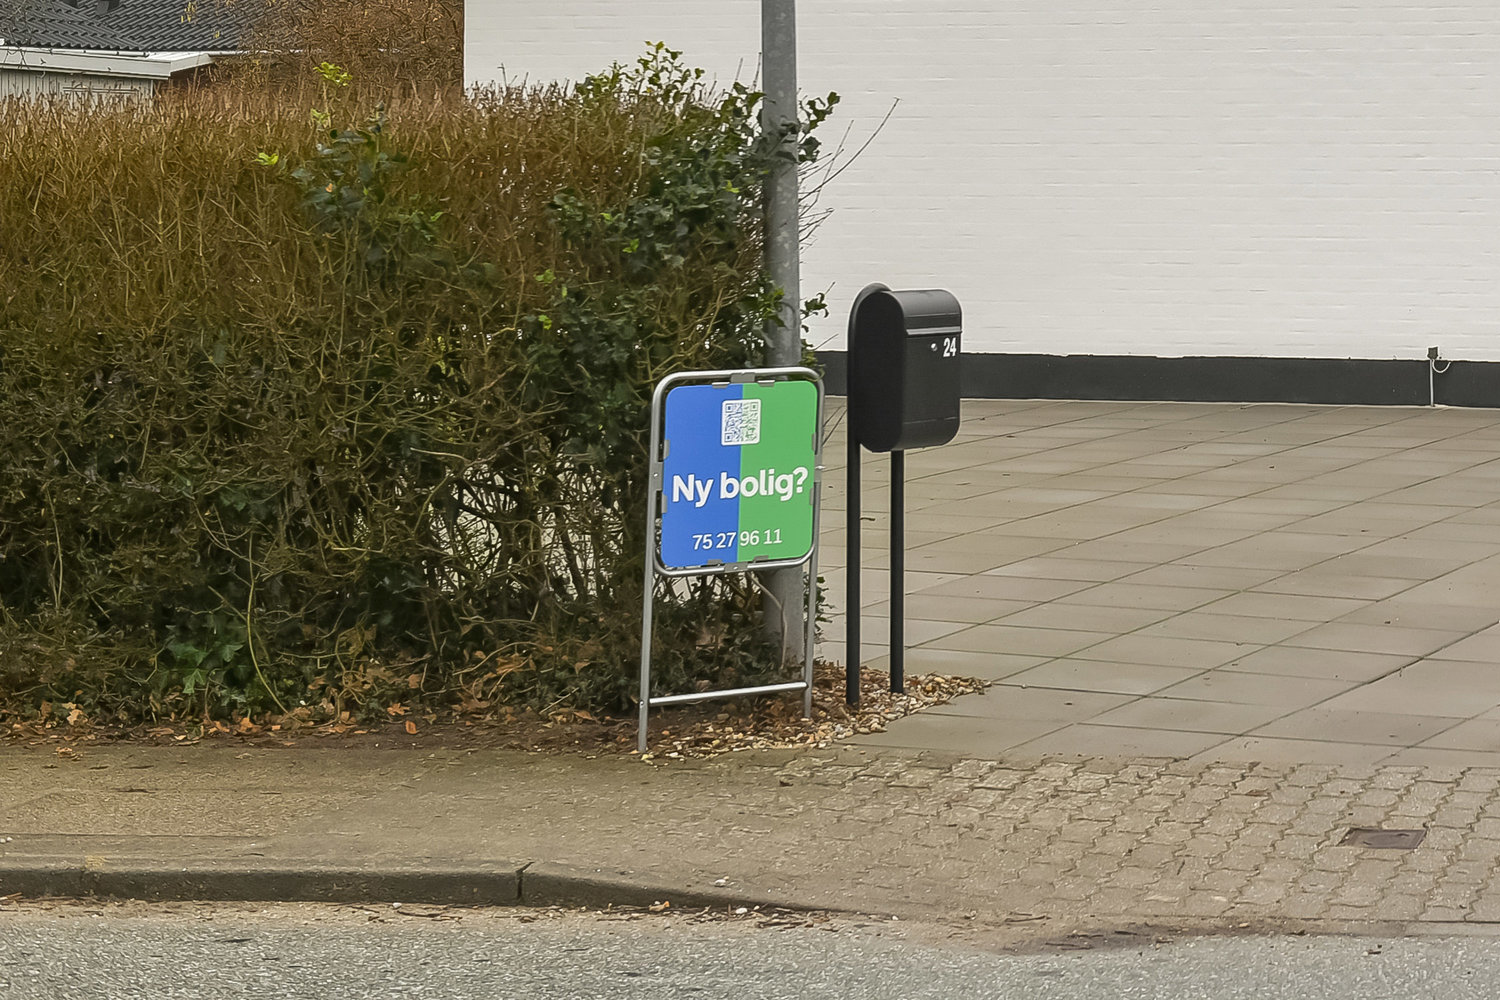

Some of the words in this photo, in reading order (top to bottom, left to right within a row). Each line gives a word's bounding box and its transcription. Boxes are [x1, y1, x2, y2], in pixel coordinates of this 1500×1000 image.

[943, 337, 957, 357] 24
[672, 474, 714, 508] Ny
[719, 467, 809, 502] bolig?
[692, 534, 713, 550] 75
[716, 532, 736, 549] 27
[739, 530, 760, 546] 96
[763, 528, 783, 545] 11
